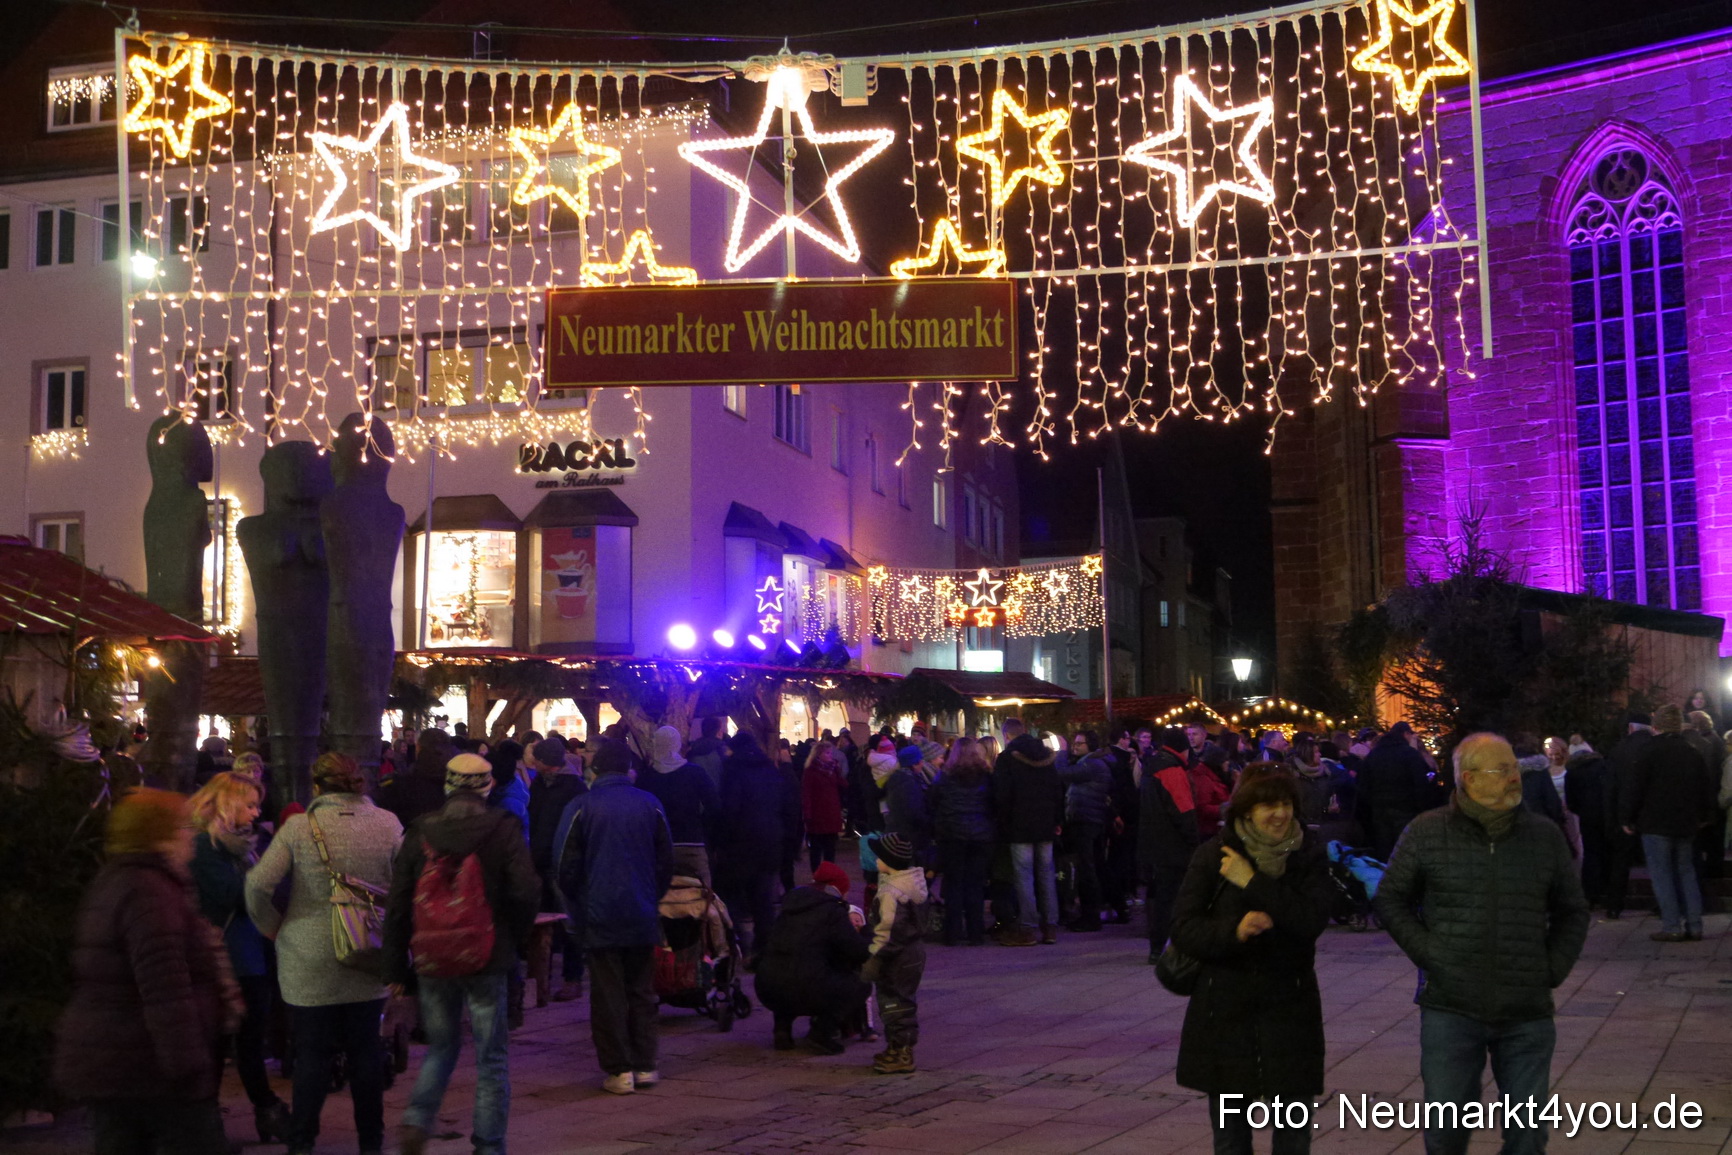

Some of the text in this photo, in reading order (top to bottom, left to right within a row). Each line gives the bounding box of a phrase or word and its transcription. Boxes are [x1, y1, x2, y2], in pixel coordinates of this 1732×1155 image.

[558, 305, 1005, 356] Neumarkter Weihnachtsmarkt
[519, 438, 636, 473] RACKL
[535, 471, 625, 489] am Rathaus
